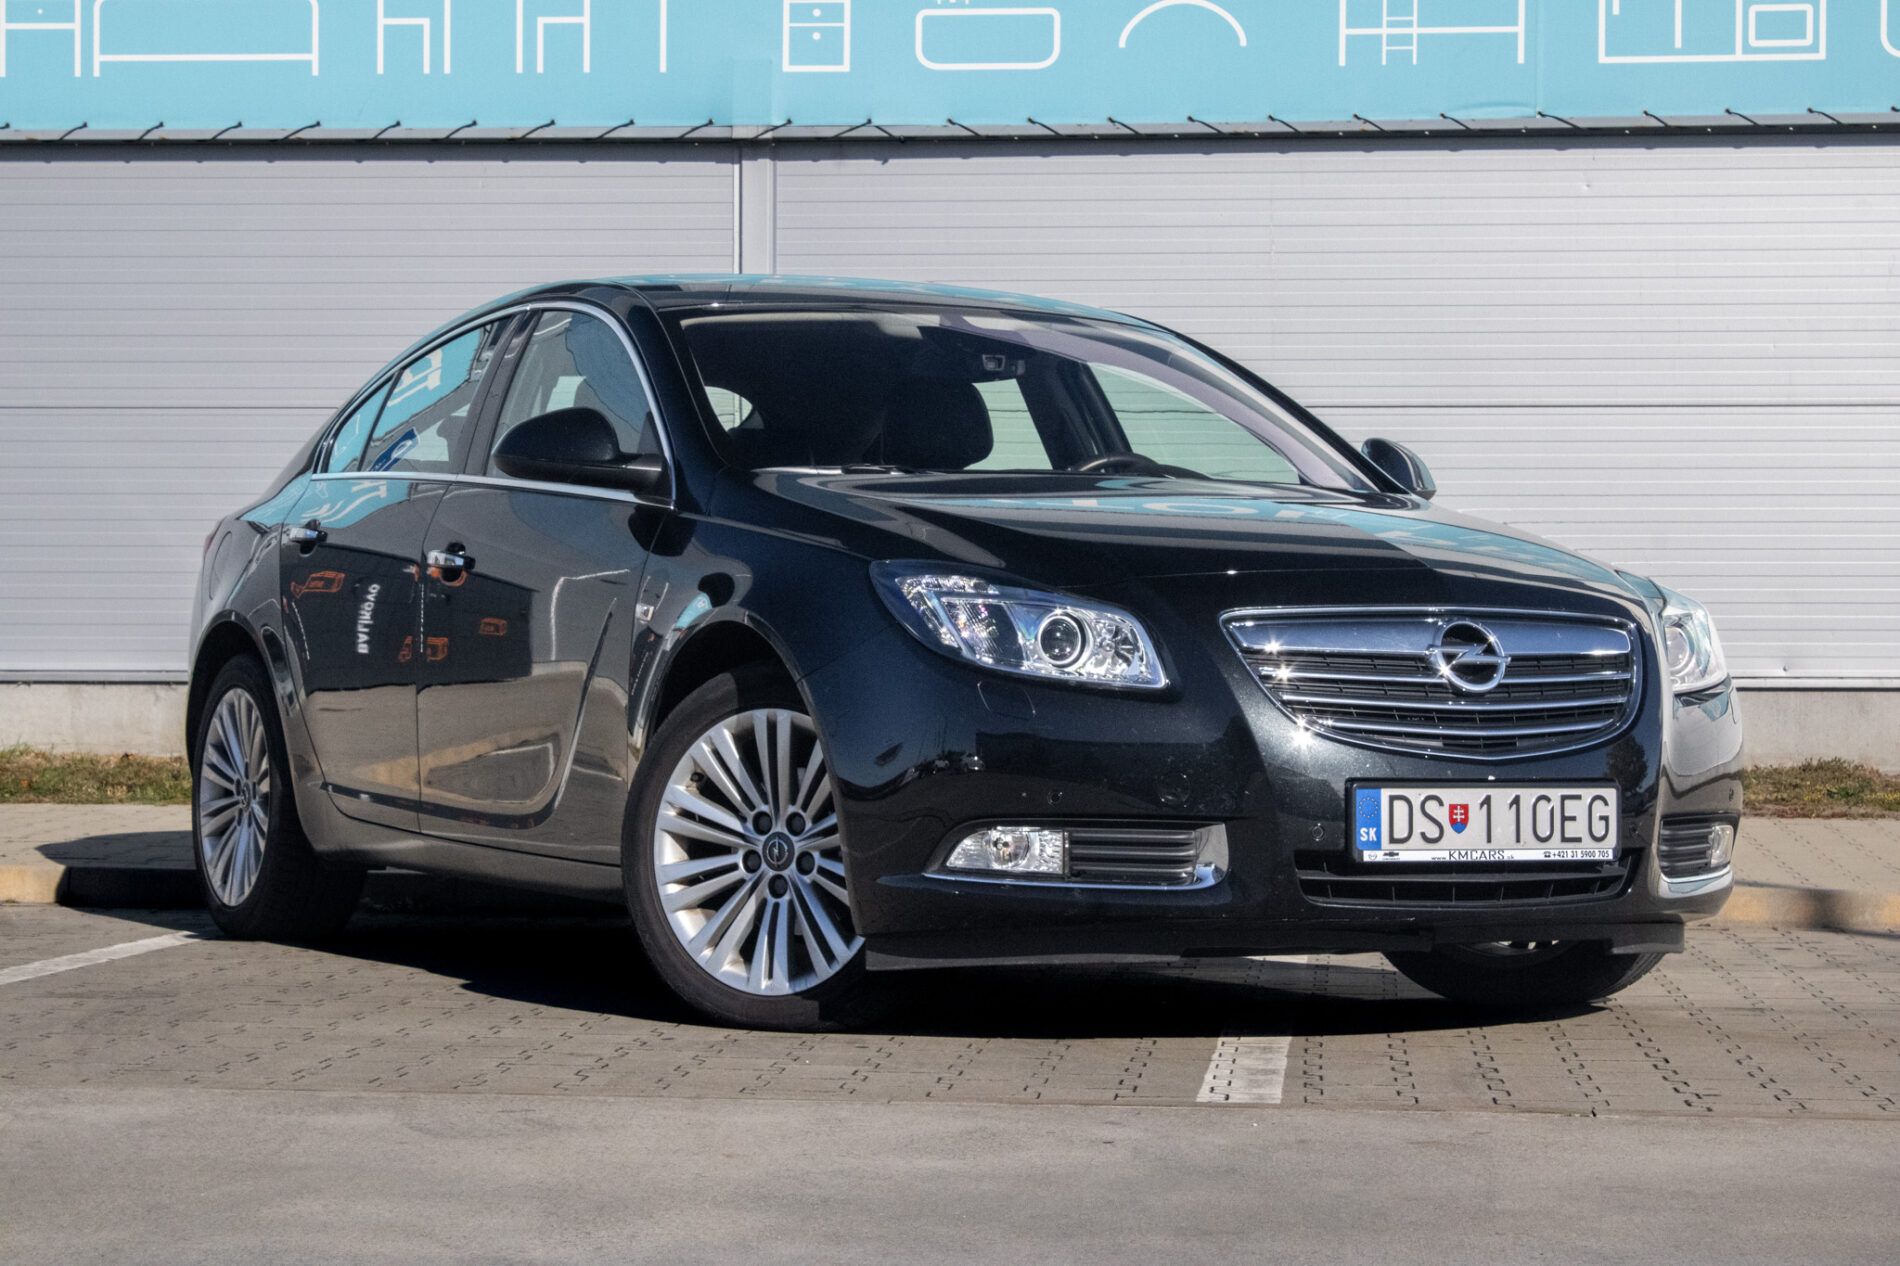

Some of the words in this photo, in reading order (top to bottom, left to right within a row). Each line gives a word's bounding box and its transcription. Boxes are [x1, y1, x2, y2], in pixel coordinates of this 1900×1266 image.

[1359, 827, 1377, 842] SK
[1388, 794, 1445, 845] DS
[1478, 794, 1610, 844] 110EG
